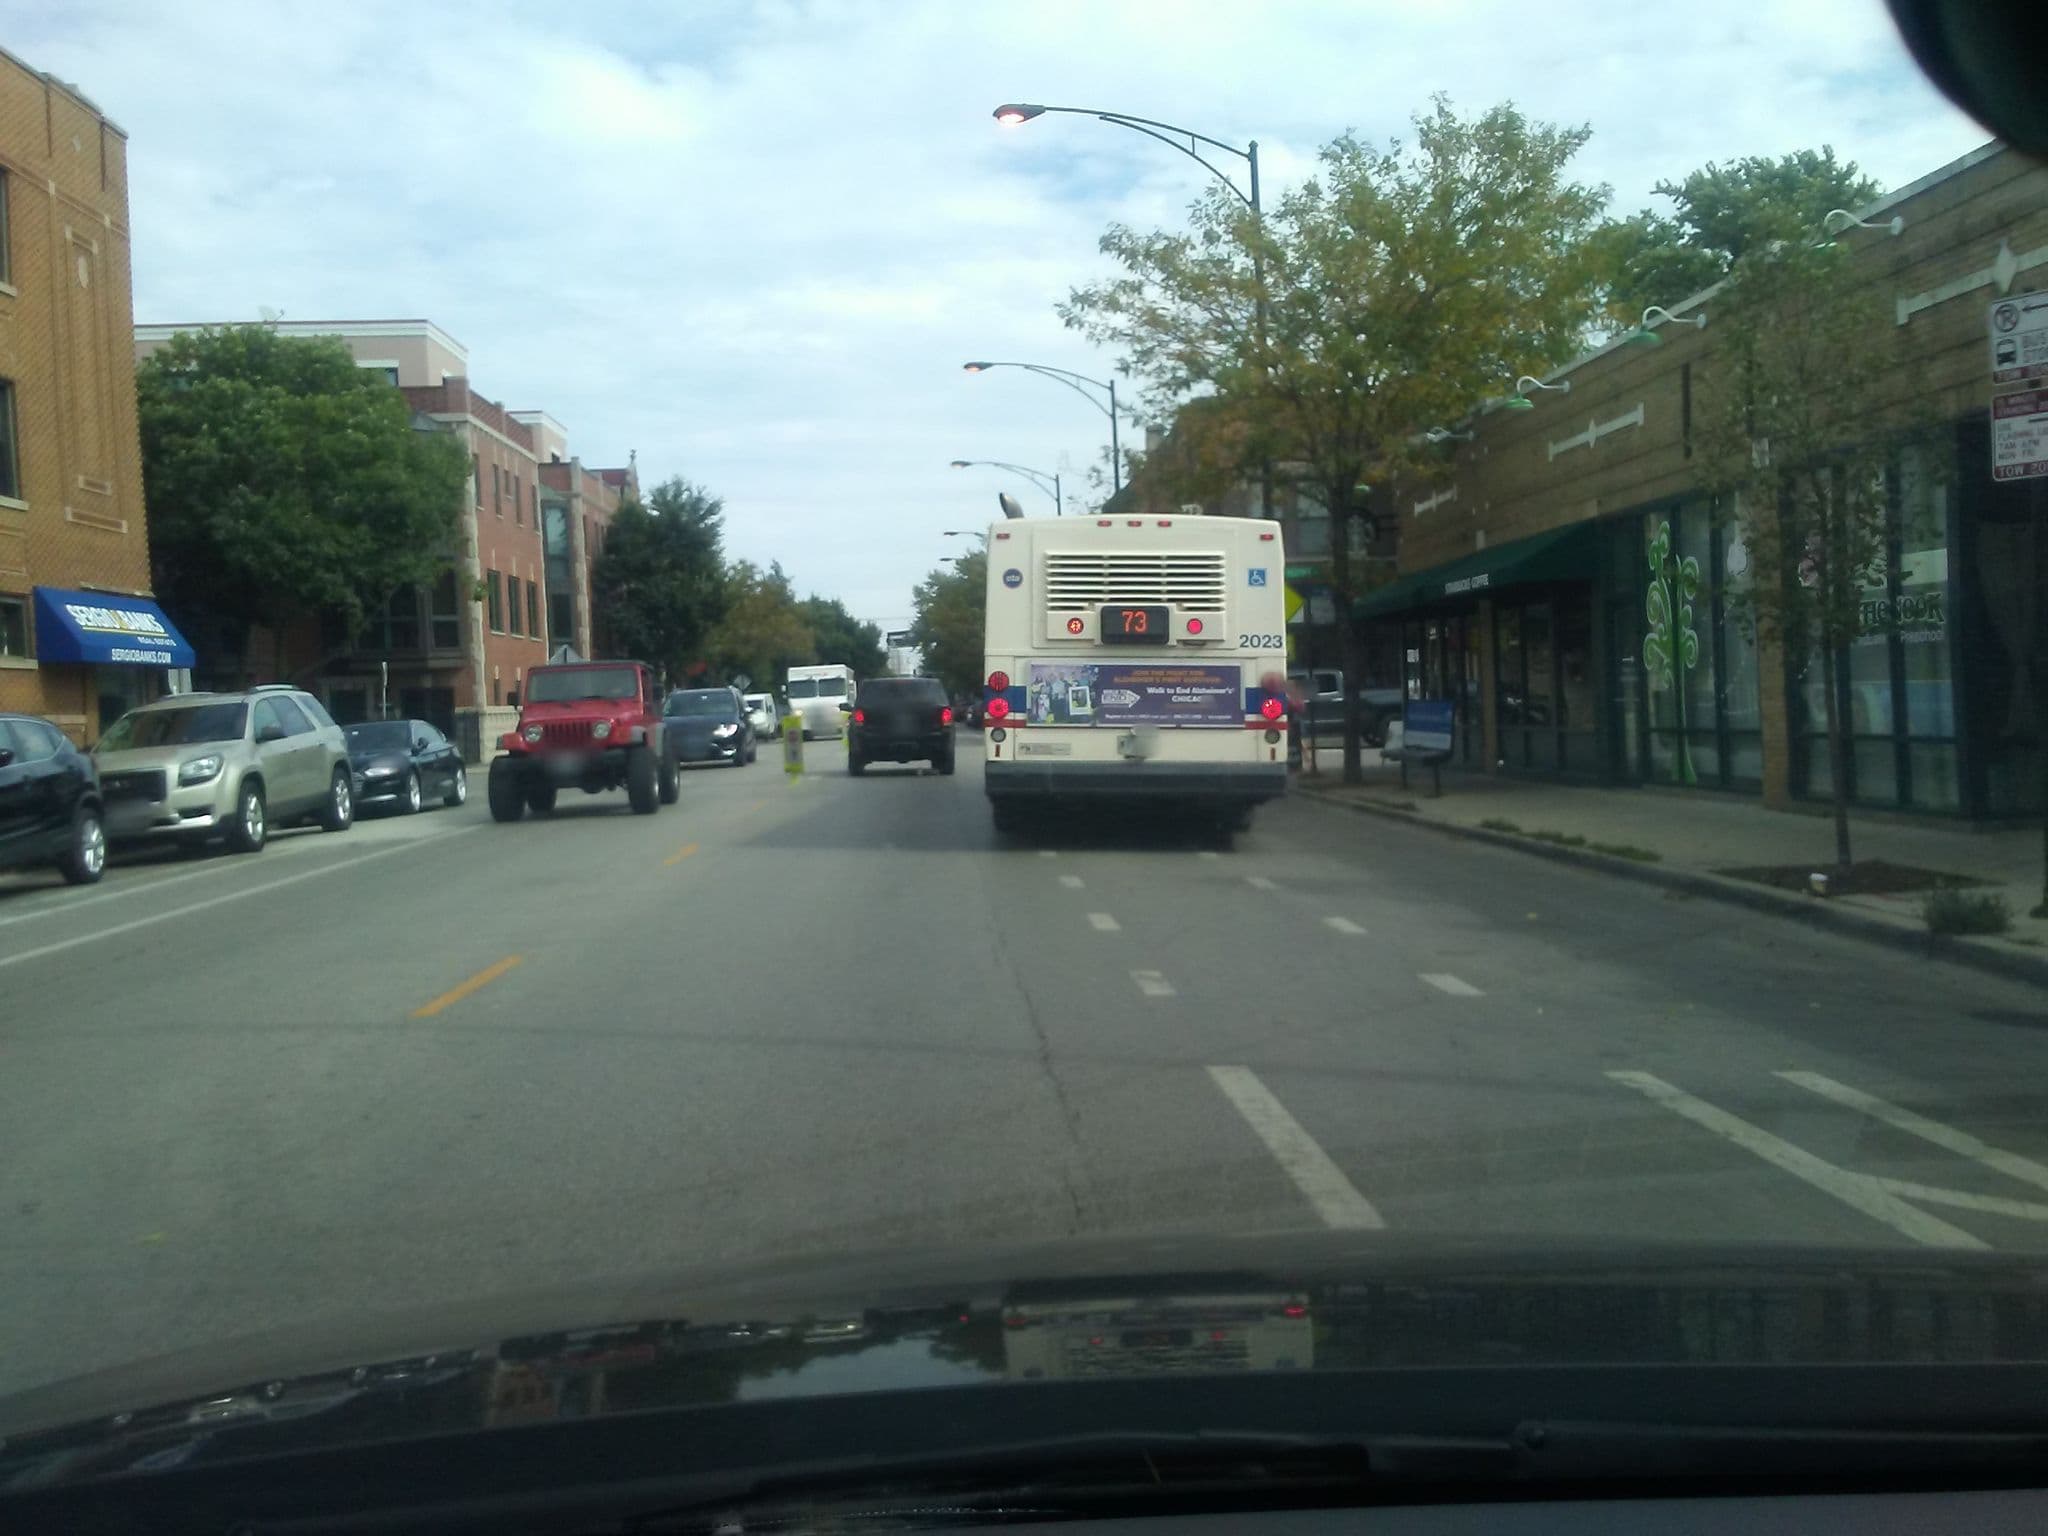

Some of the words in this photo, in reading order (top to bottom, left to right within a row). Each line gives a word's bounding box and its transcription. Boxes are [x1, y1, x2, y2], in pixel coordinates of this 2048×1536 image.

[1999, 464, 2024, 477] TOW
[1122, 611, 1147, 633] 73
[1239, 635, 1283, 649] 2023
[112, 648, 172, 664] SERGIOBANKS.COM
[1172, 695, 1207, 703] CHICA
